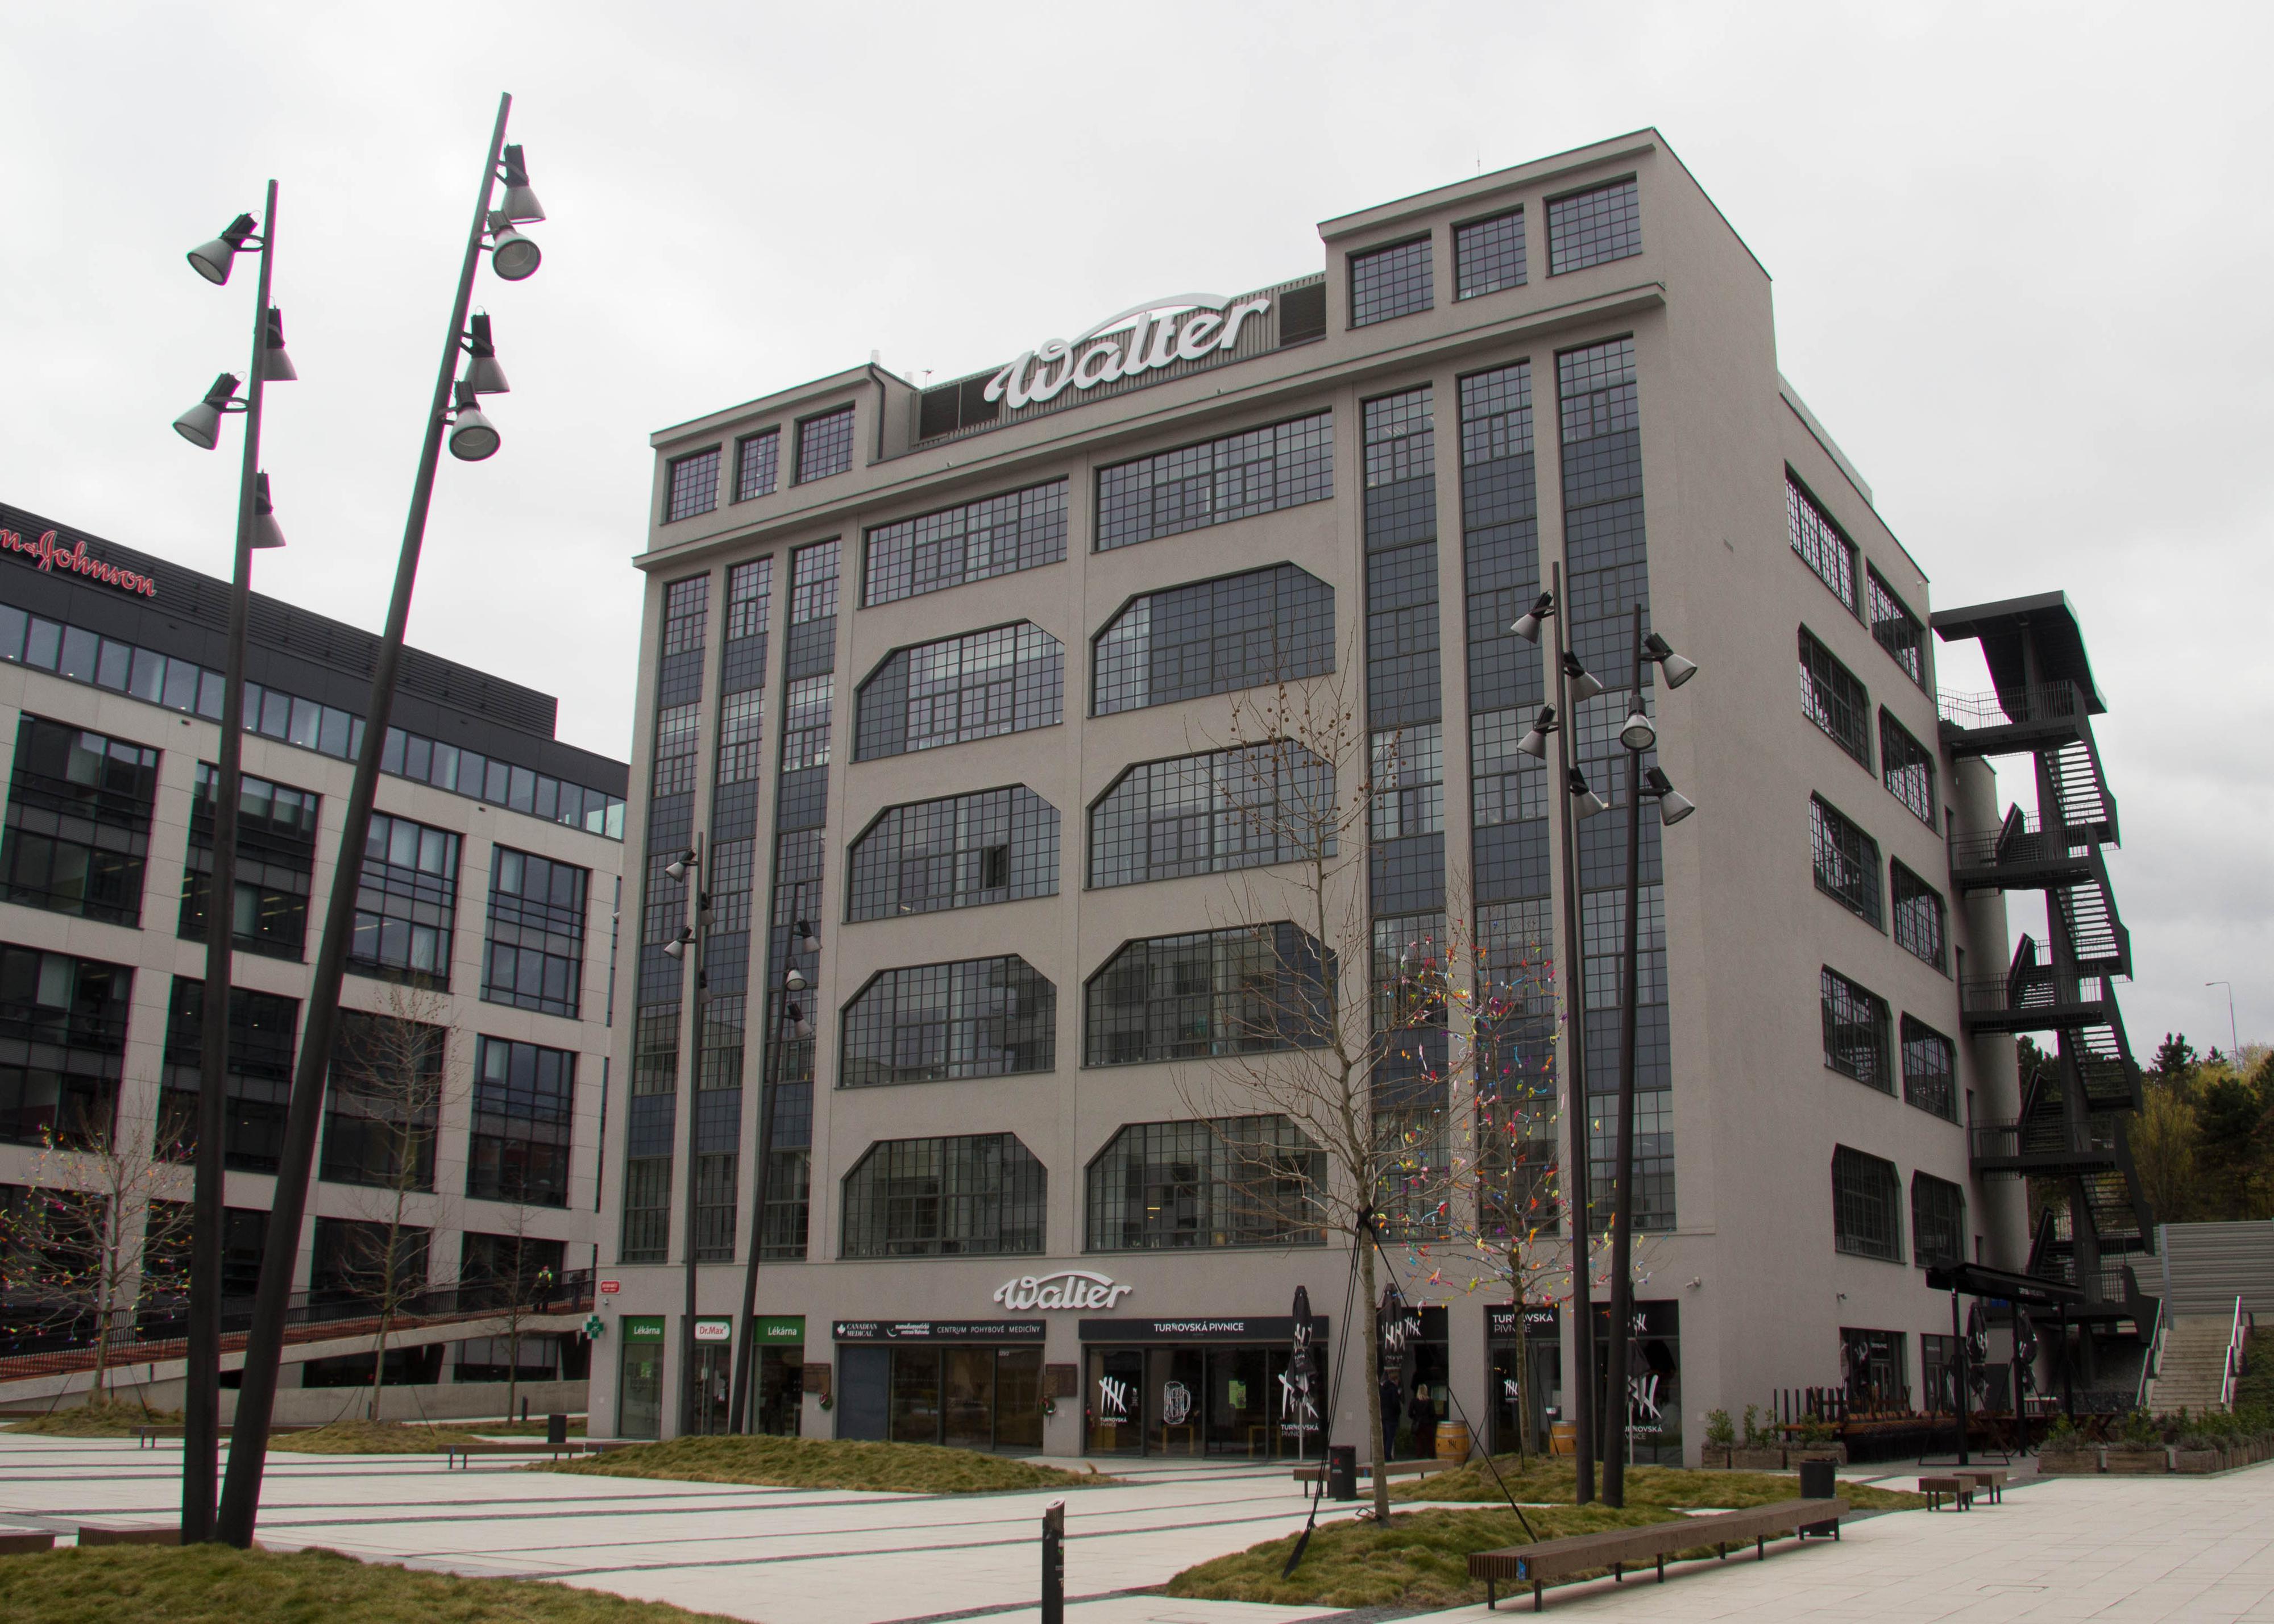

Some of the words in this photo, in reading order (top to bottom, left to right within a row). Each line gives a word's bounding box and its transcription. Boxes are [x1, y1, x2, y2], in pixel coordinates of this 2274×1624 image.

[984, 292, 1270, 408] Walter
[39, 530, 157, 597] Johnson
[993, 1270, 1132, 1310] Walter
[634, 1326, 660, 1335] Lékárna
[699, 1326, 724, 1335] Dr.Max
[767, 1326, 797, 1336] Lékárna
[1209, 1322, 1244, 1331] PIVNICE
